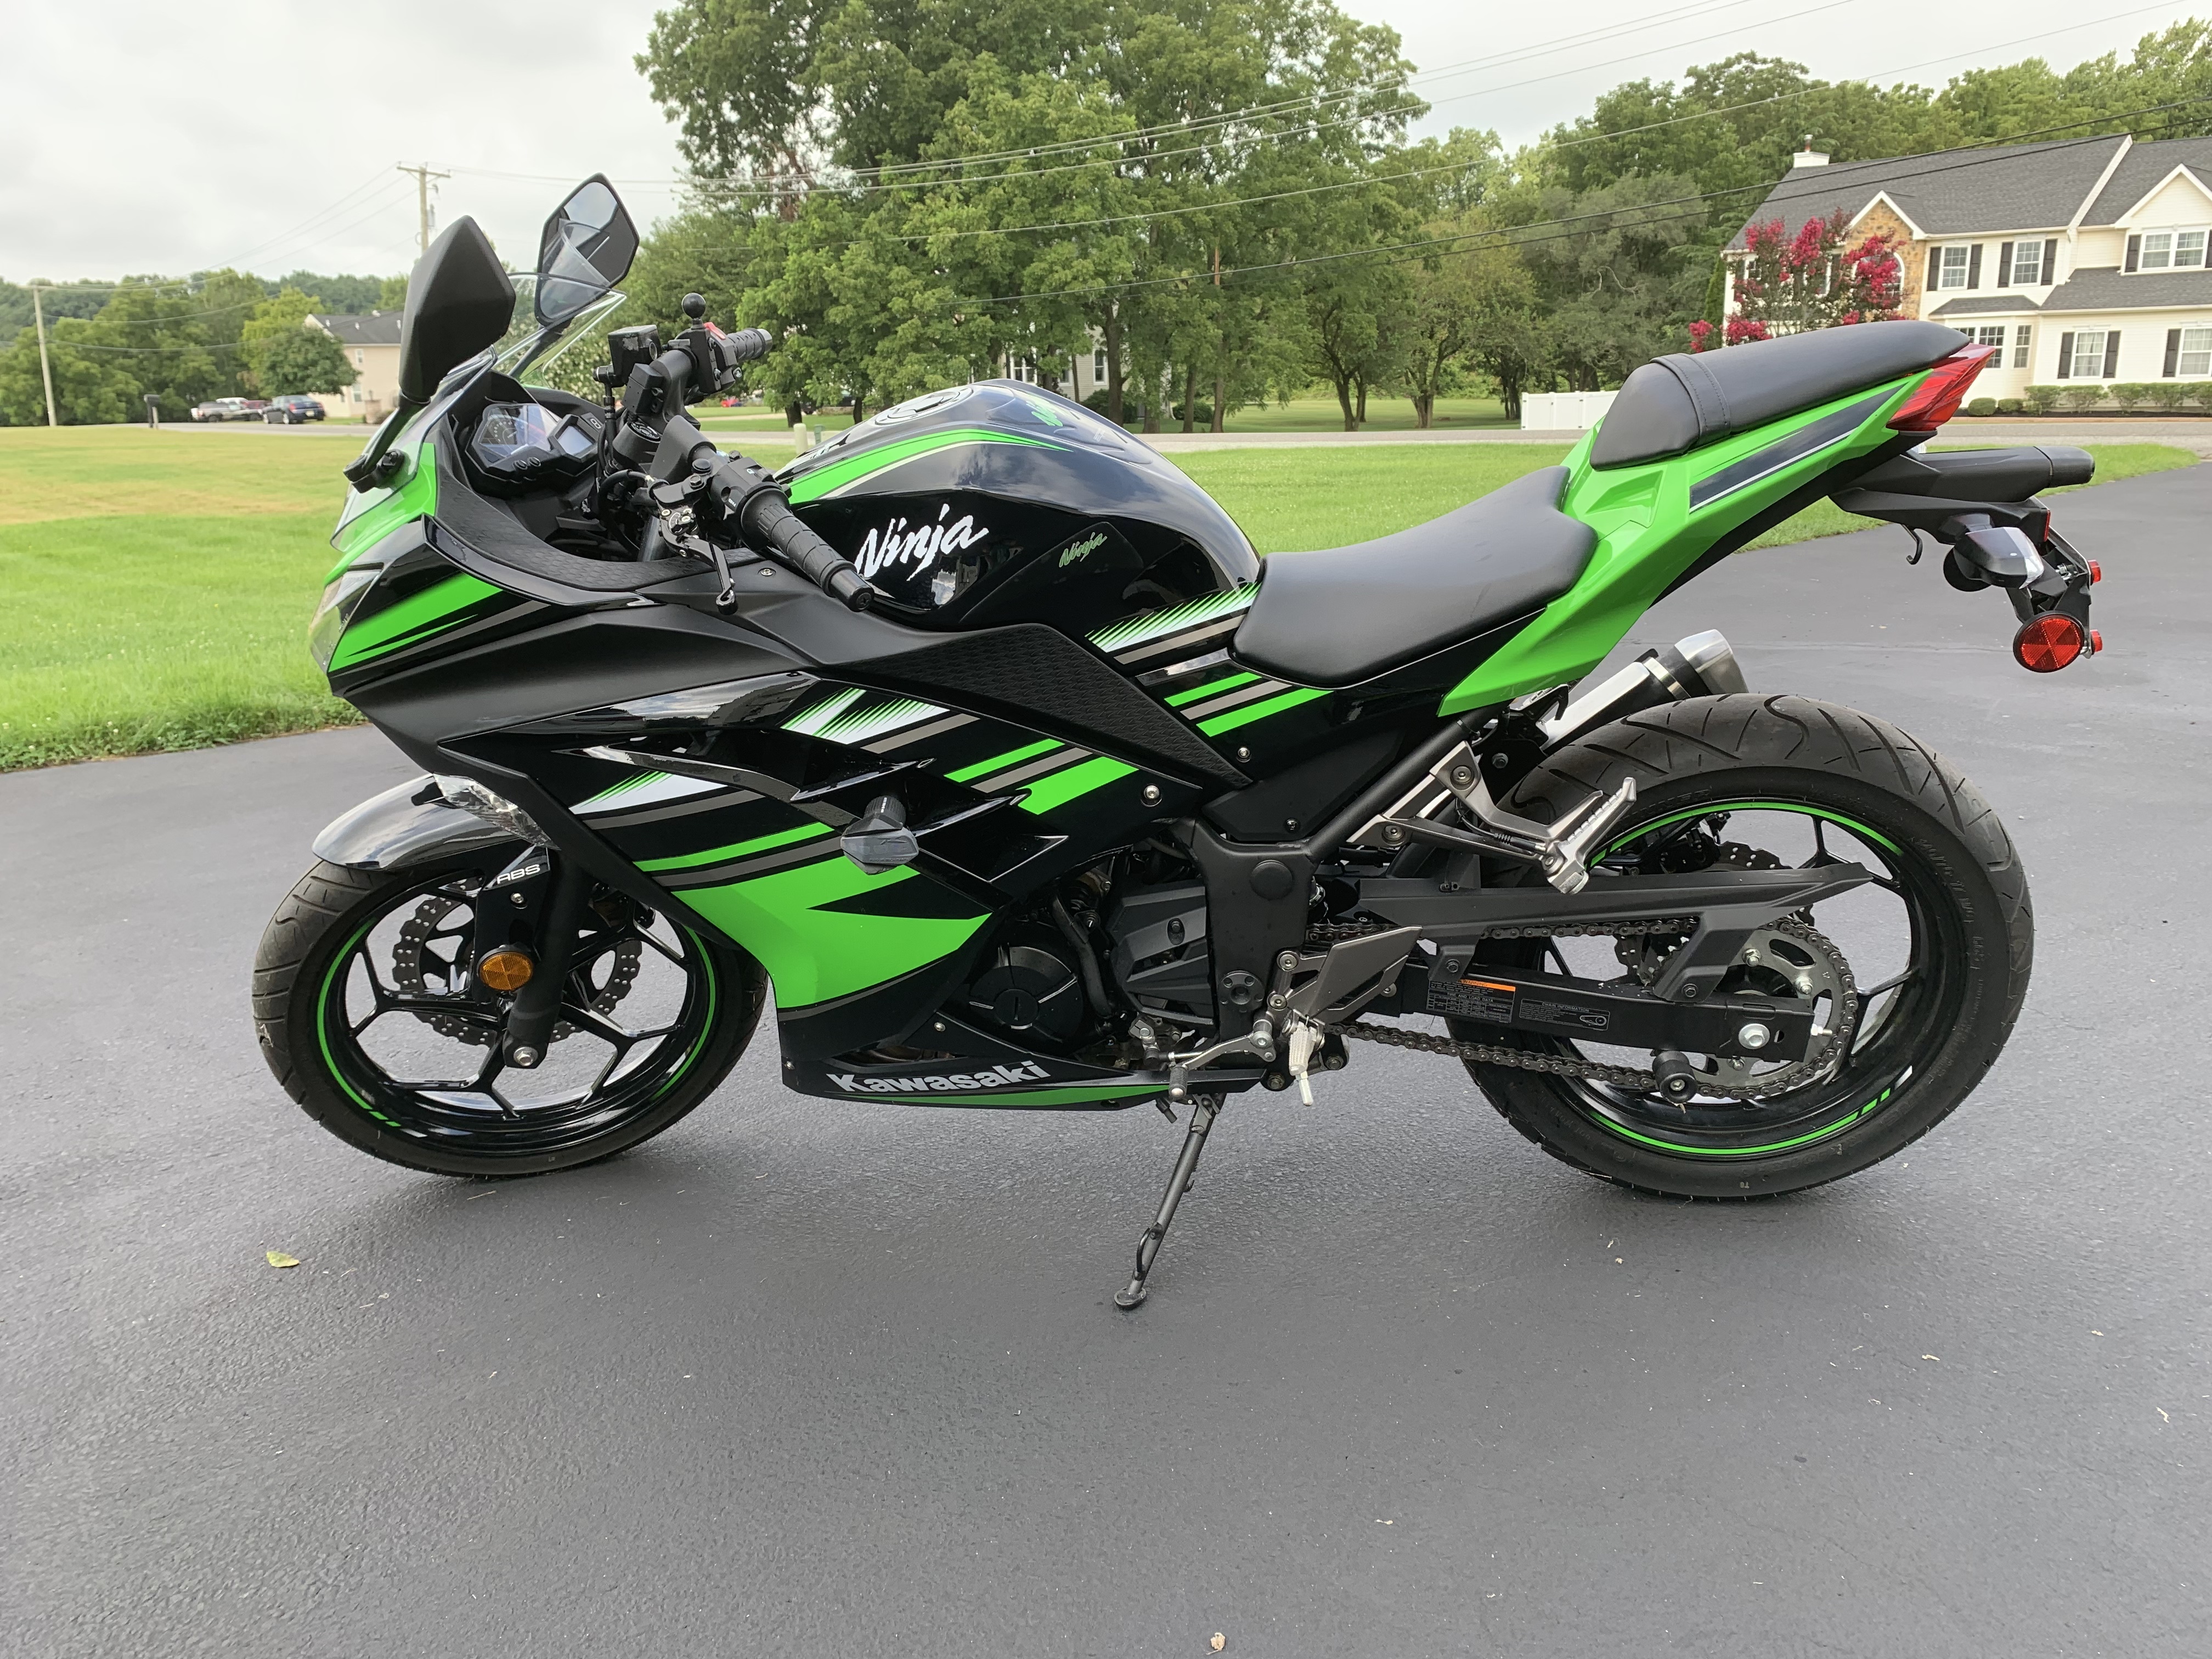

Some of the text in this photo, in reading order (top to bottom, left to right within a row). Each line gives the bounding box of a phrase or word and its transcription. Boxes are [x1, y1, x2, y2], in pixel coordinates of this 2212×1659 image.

[854, 503, 989, 582] Ninja
[1058, 531, 1108, 569] Ninja
[496, 864, 540, 884] ABS
[1557, 1004, 1589, 1012] INFORMATION
[826, 1060, 1051, 1092] Kawasaki
